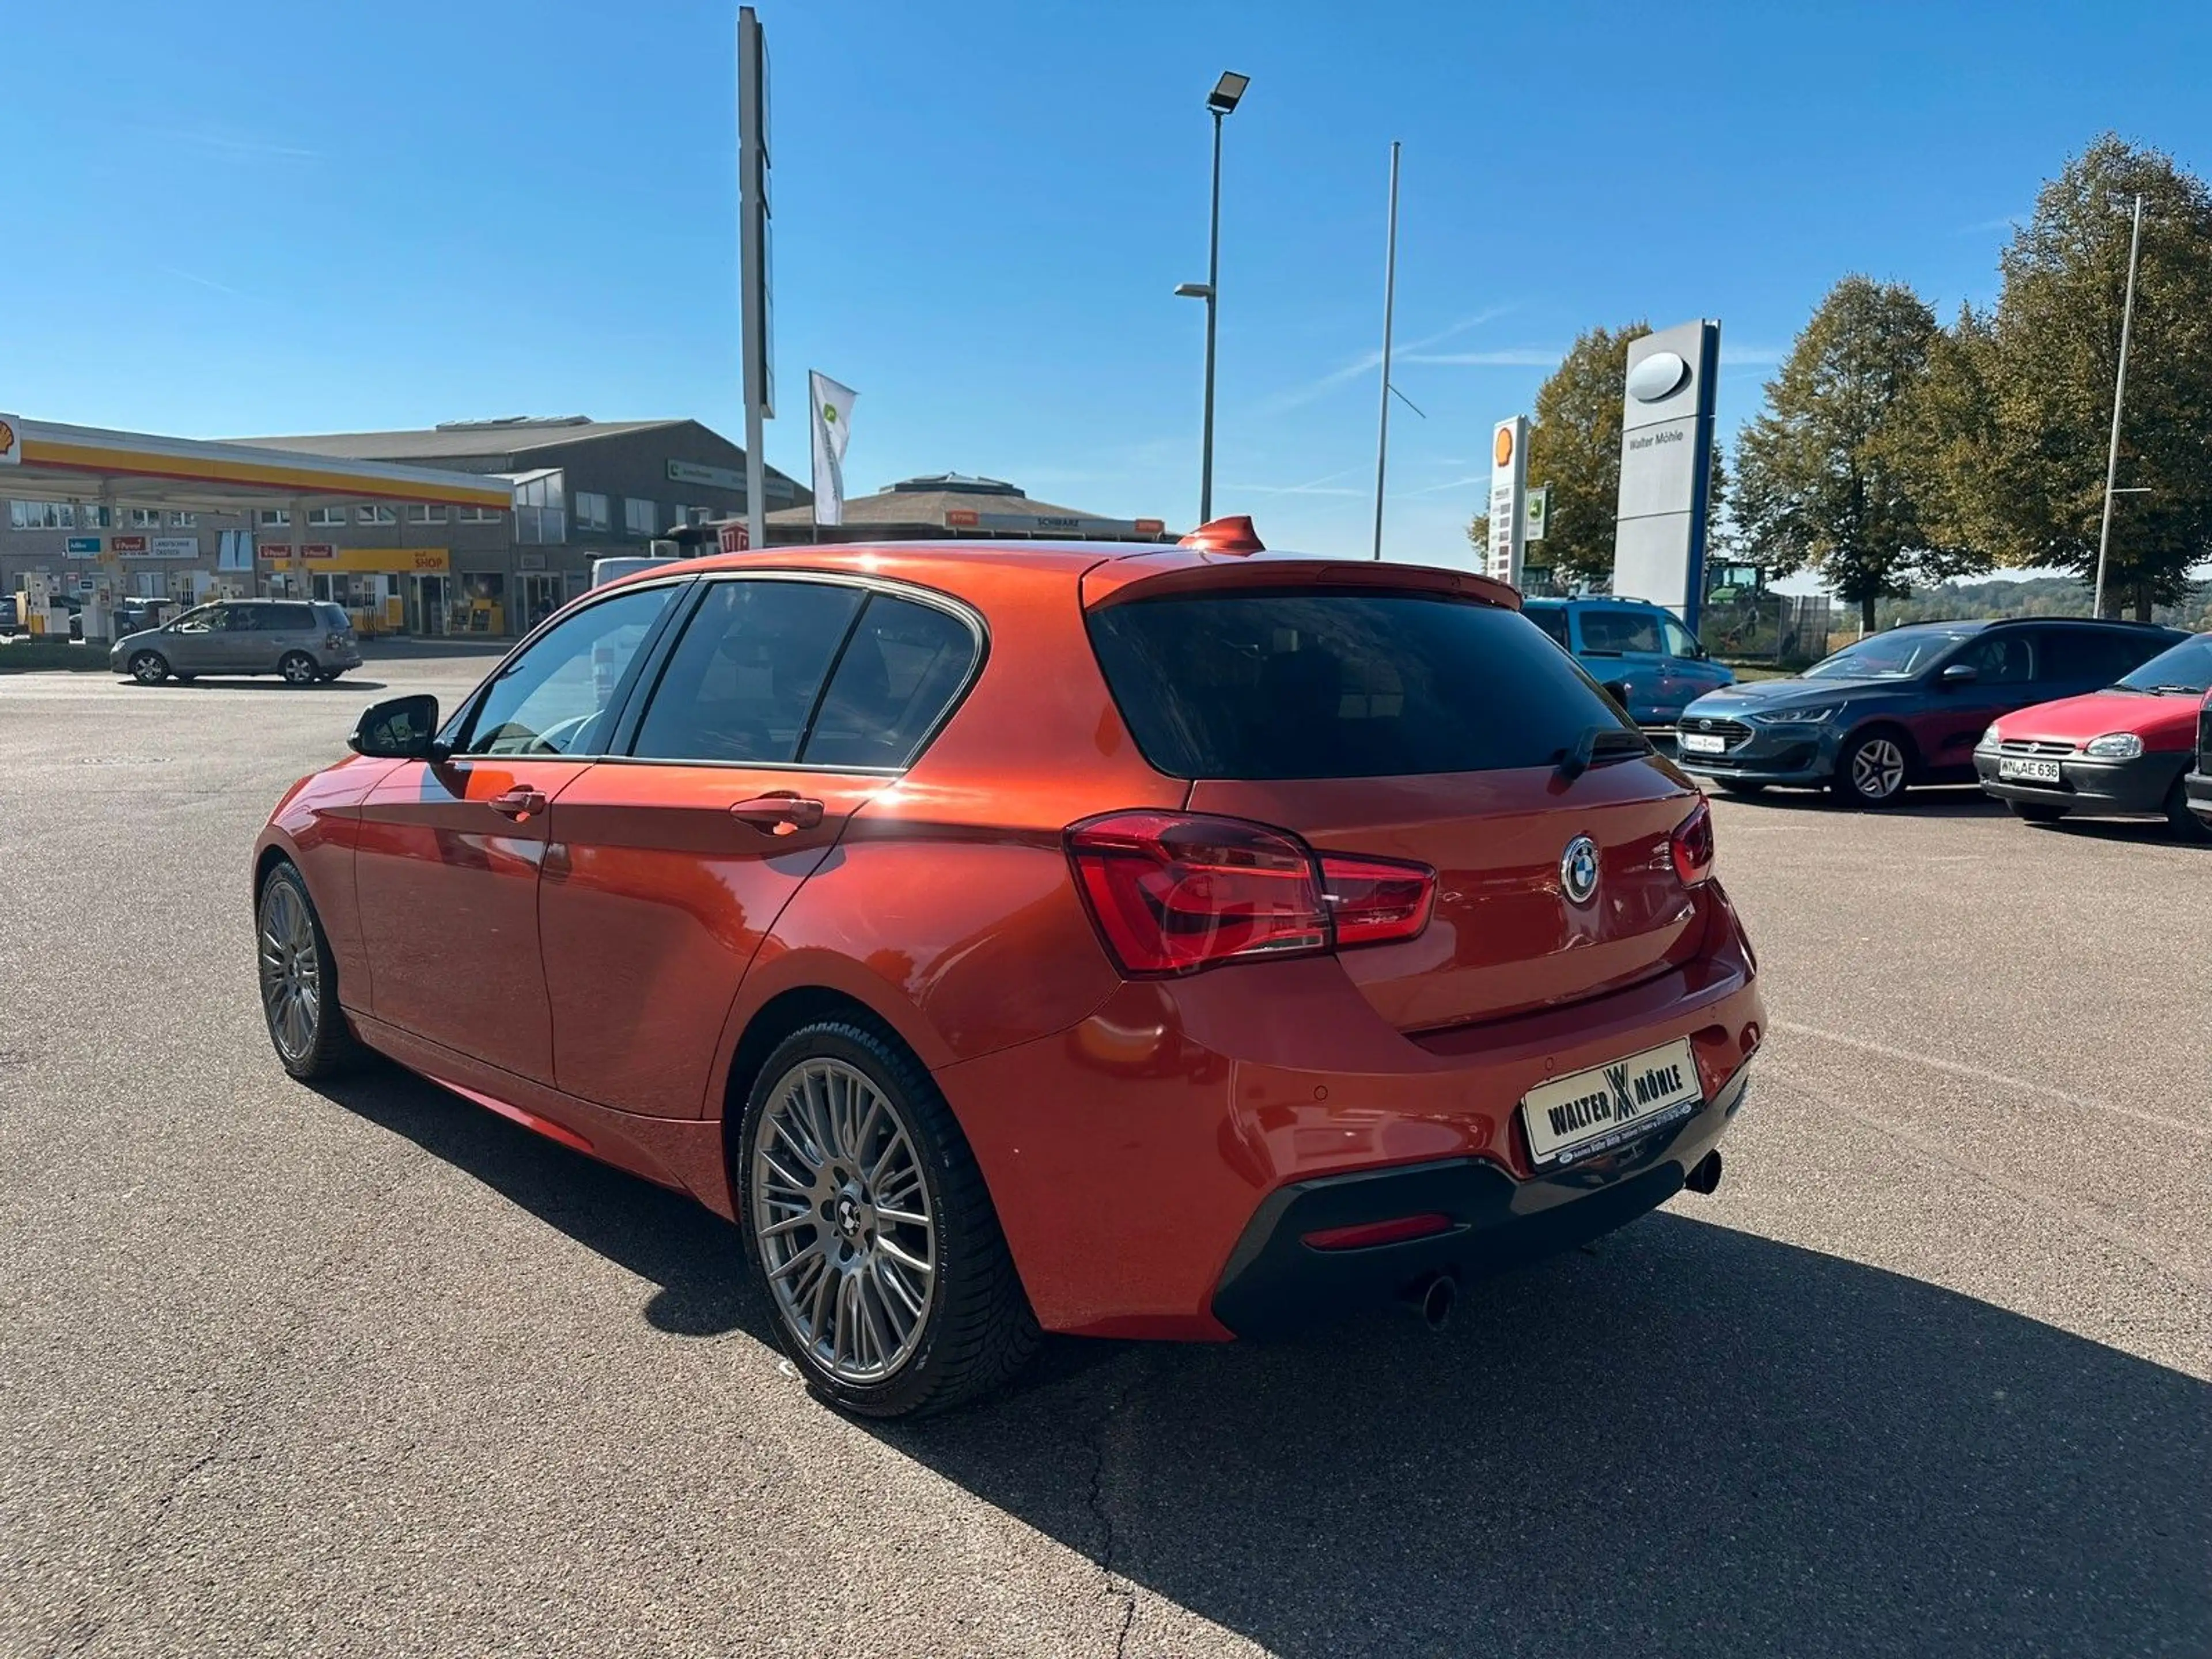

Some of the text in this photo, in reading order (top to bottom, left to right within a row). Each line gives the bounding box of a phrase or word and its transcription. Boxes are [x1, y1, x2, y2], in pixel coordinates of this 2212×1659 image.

[1630, 437, 1654, 450] Walter
[415, 558, 442, 568] SHOP
[2021, 762, 2036, 775] AE
[2038, 763, 2058, 778] 636
[1547, 1065, 1684, 1136] WALTER MÖHLE
